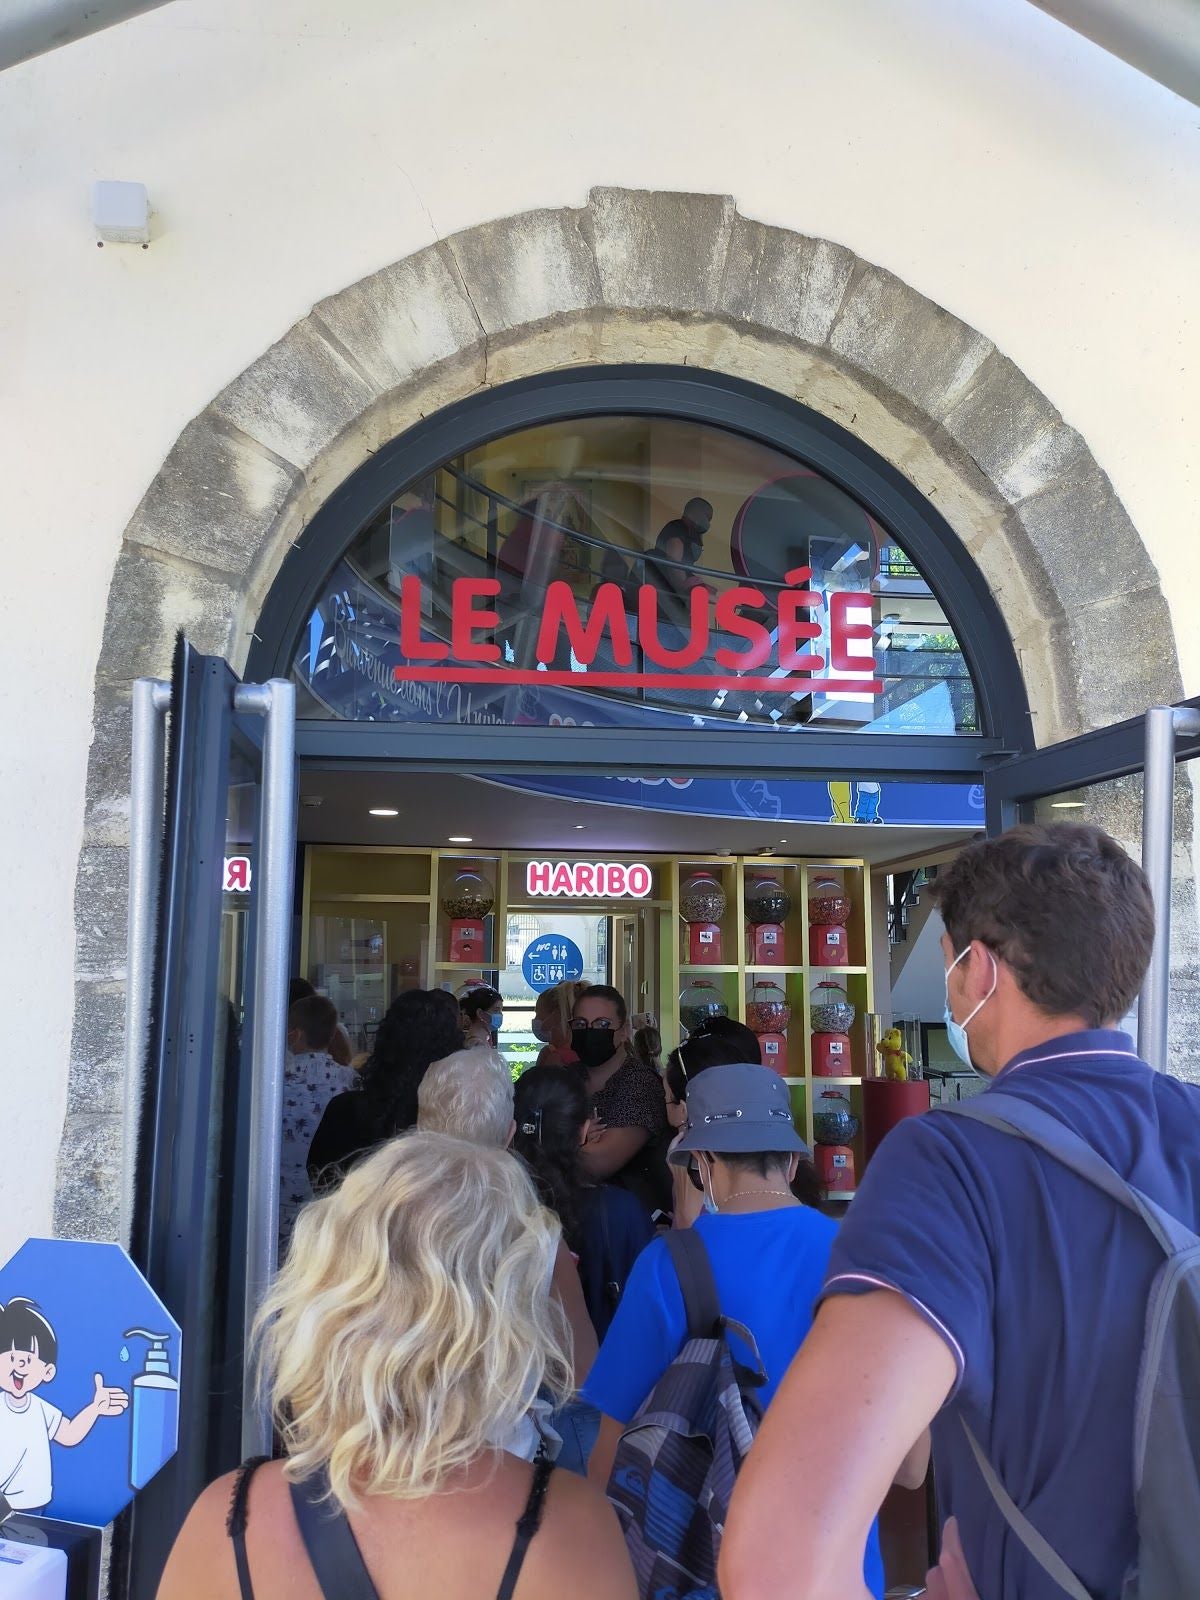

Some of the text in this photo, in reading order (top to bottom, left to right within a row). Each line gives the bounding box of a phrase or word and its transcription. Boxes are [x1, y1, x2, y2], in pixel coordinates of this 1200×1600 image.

[401, 567, 877, 672] LE MUSÉE
[527, 861, 652, 897] HARIBO
[536, 942, 551, 952] WC
